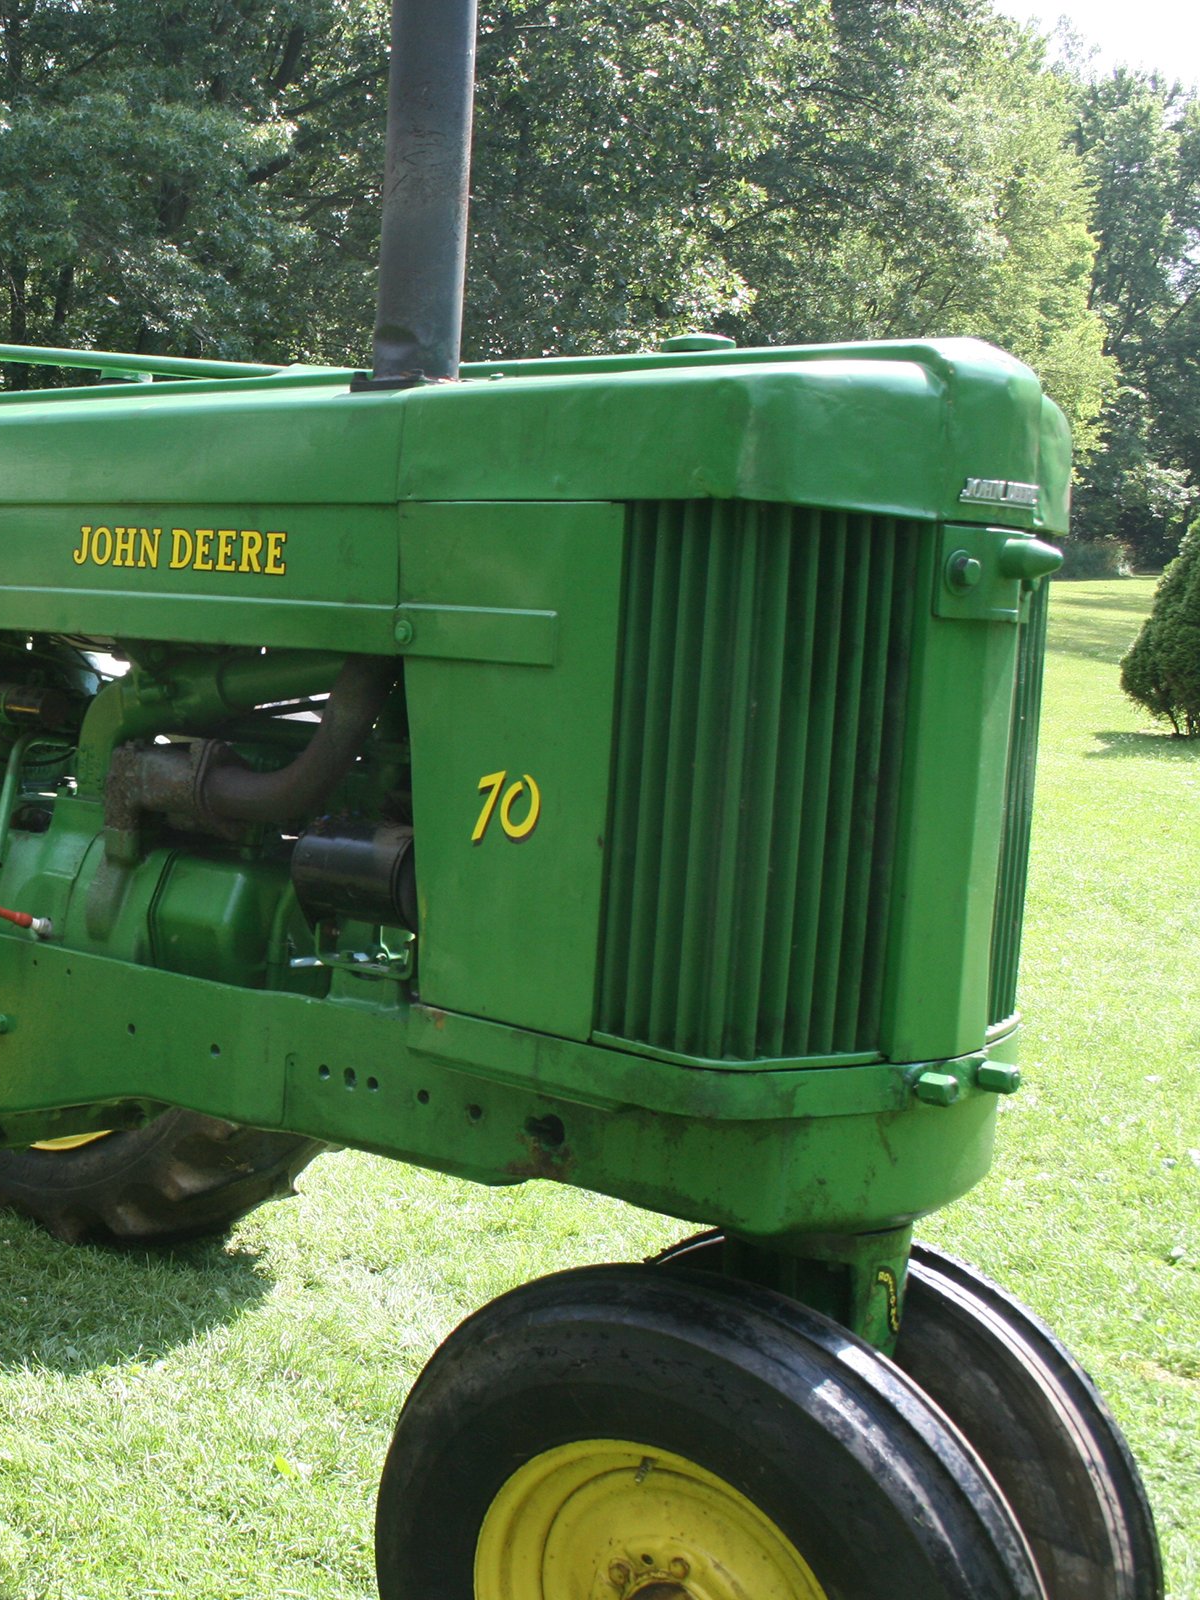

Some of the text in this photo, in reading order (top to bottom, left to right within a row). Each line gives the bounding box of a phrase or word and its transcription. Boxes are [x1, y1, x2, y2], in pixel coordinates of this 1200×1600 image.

[73, 526, 287, 575] JOHN DEERE
[471, 770, 541, 846] 70
